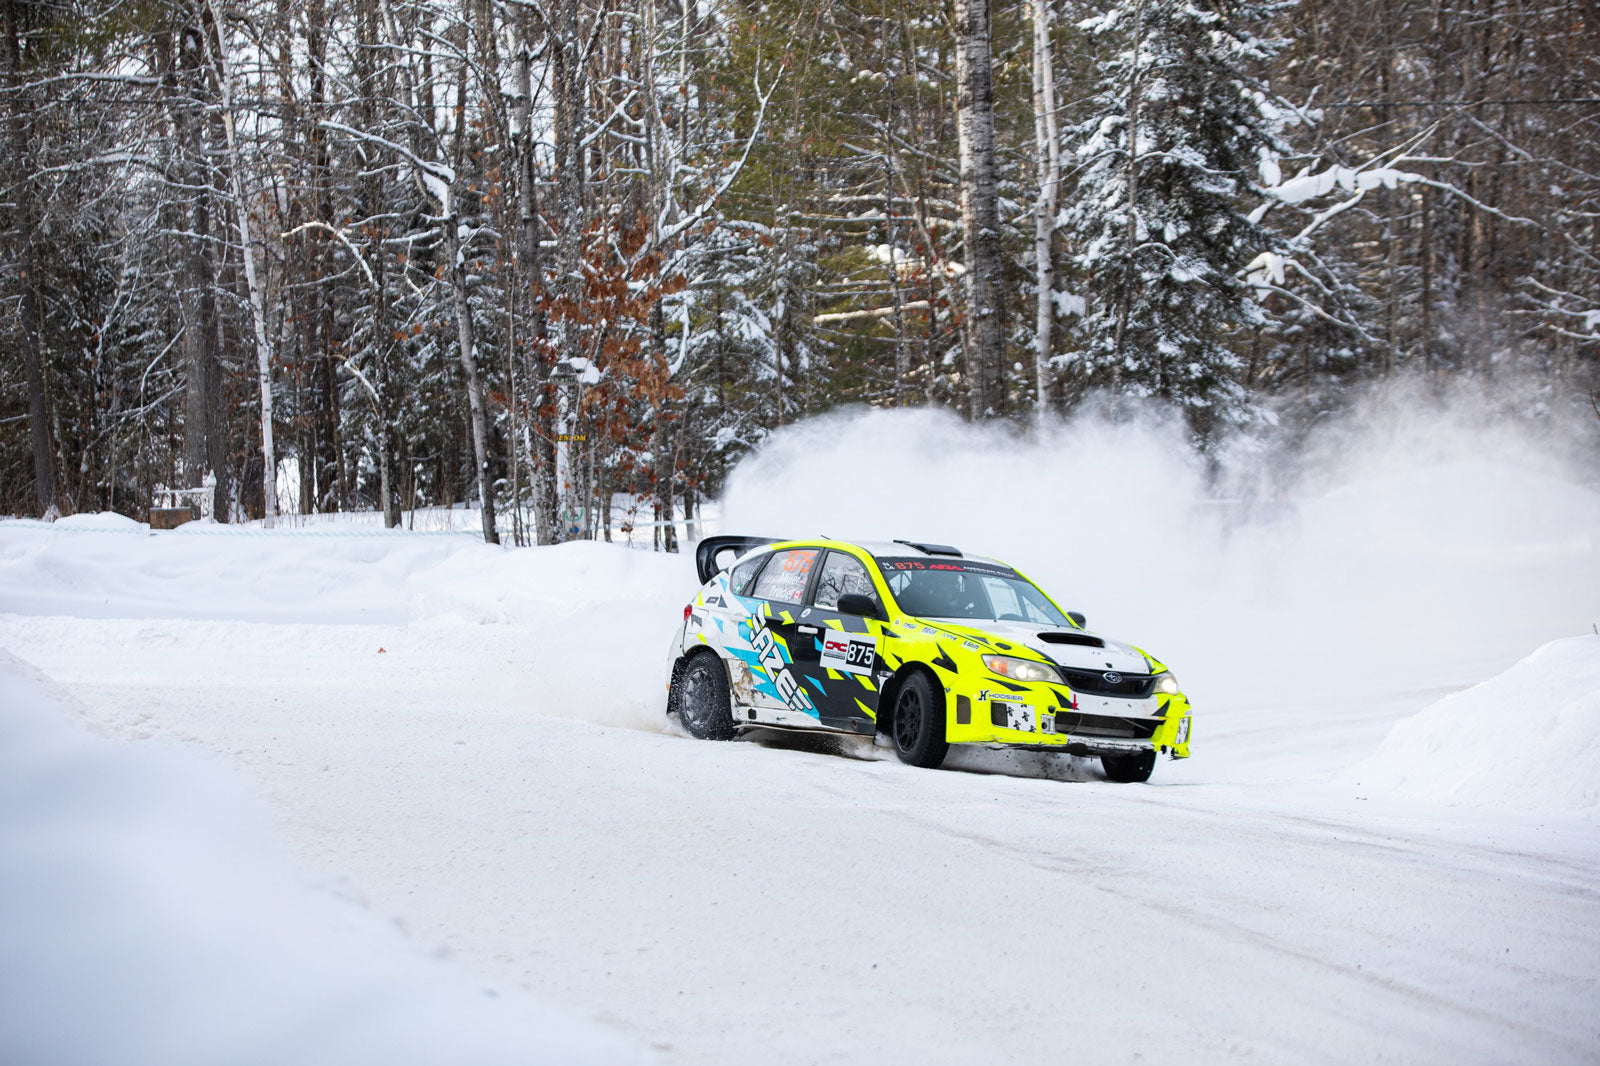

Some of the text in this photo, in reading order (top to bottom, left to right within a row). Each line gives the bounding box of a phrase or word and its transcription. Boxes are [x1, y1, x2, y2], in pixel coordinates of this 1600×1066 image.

[783, 550, 817, 574] 875
[894, 562, 926, 570] 875
[847, 643, 874, 665] 875
[988, 693, 1024, 701] HOOSIER
